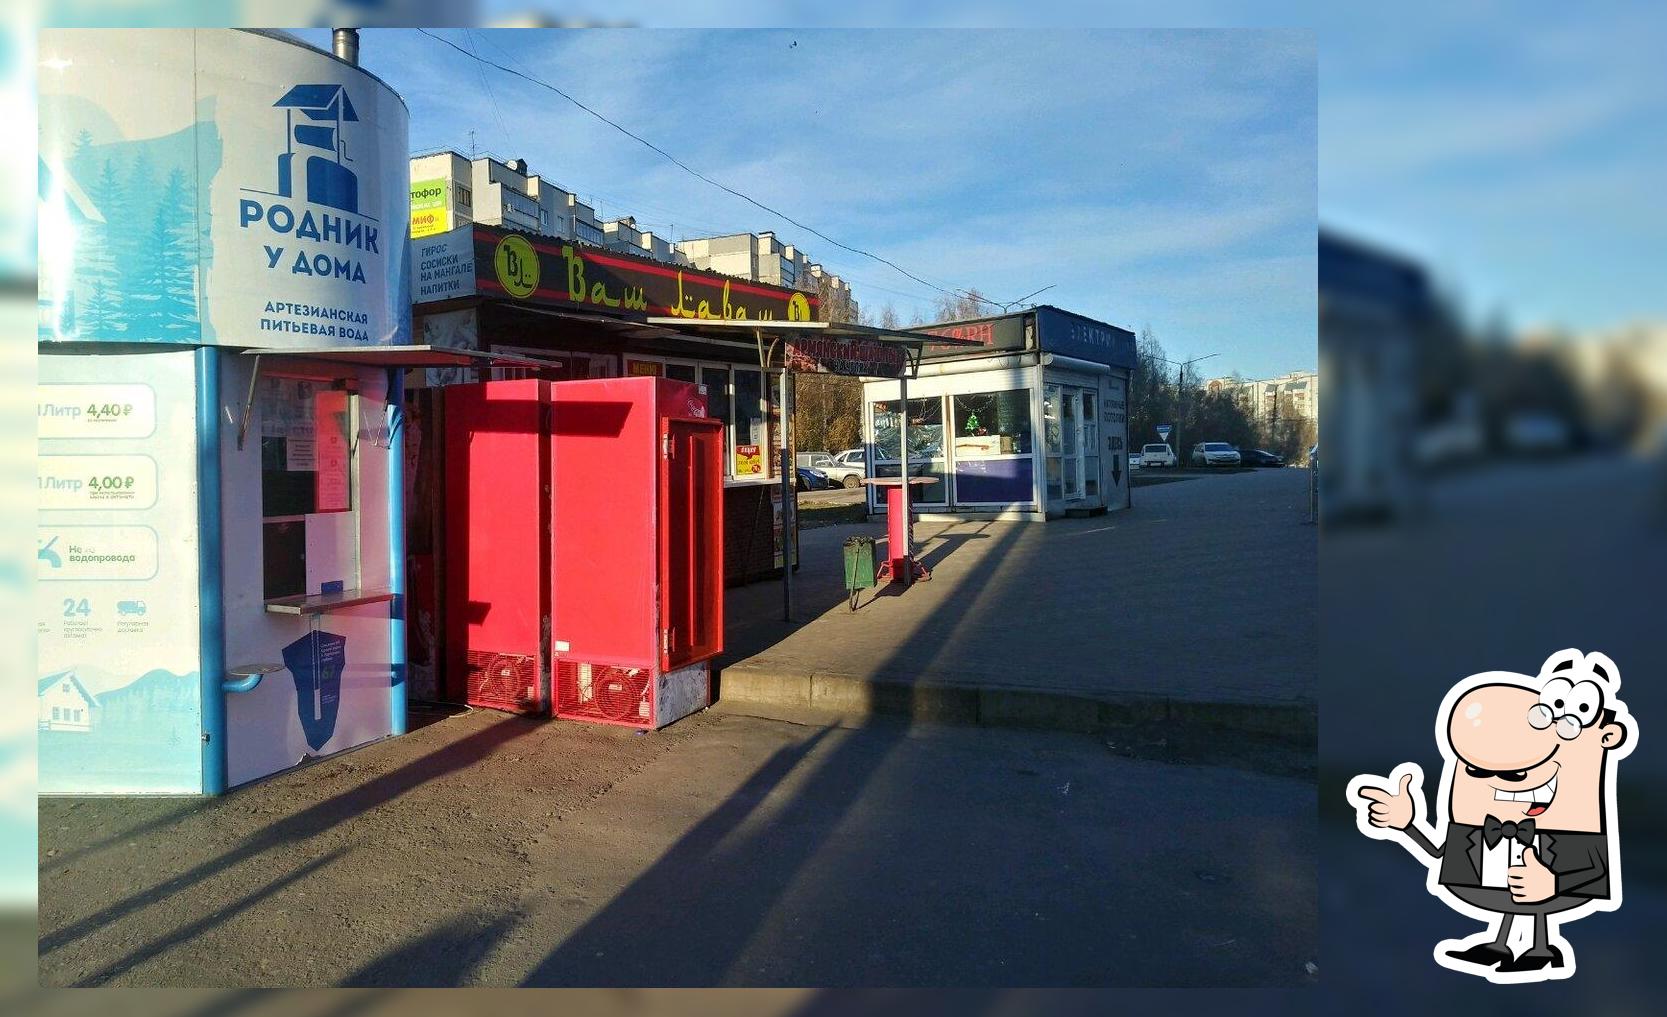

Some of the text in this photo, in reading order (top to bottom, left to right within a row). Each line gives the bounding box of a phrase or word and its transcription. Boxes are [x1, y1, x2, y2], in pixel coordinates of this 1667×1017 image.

[239, 198, 379, 254] РОДНИК
[421, 244, 448, 257] ГИРОС
[263, 245, 366, 284] У ДОМА
[420, 254, 459, 271] СОСИСКИ
[420, 262, 473, 282] НА МАНГАЛЕ
[562, 246, 648, 308] Ваш
[420, 280, 460, 296] НАПИТКИ
[264, 301, 368, 325] АРТЕЗИАНСКАЯ
[260, 318, 369, 342] ПИТЬЕВАЯ ВОДА
[43, 404, 81, 420] Литр
[44, 477, 82, 492] Литр
[69, 554, 136, 563] водопровода
[63, 598, 91, 617] 24
